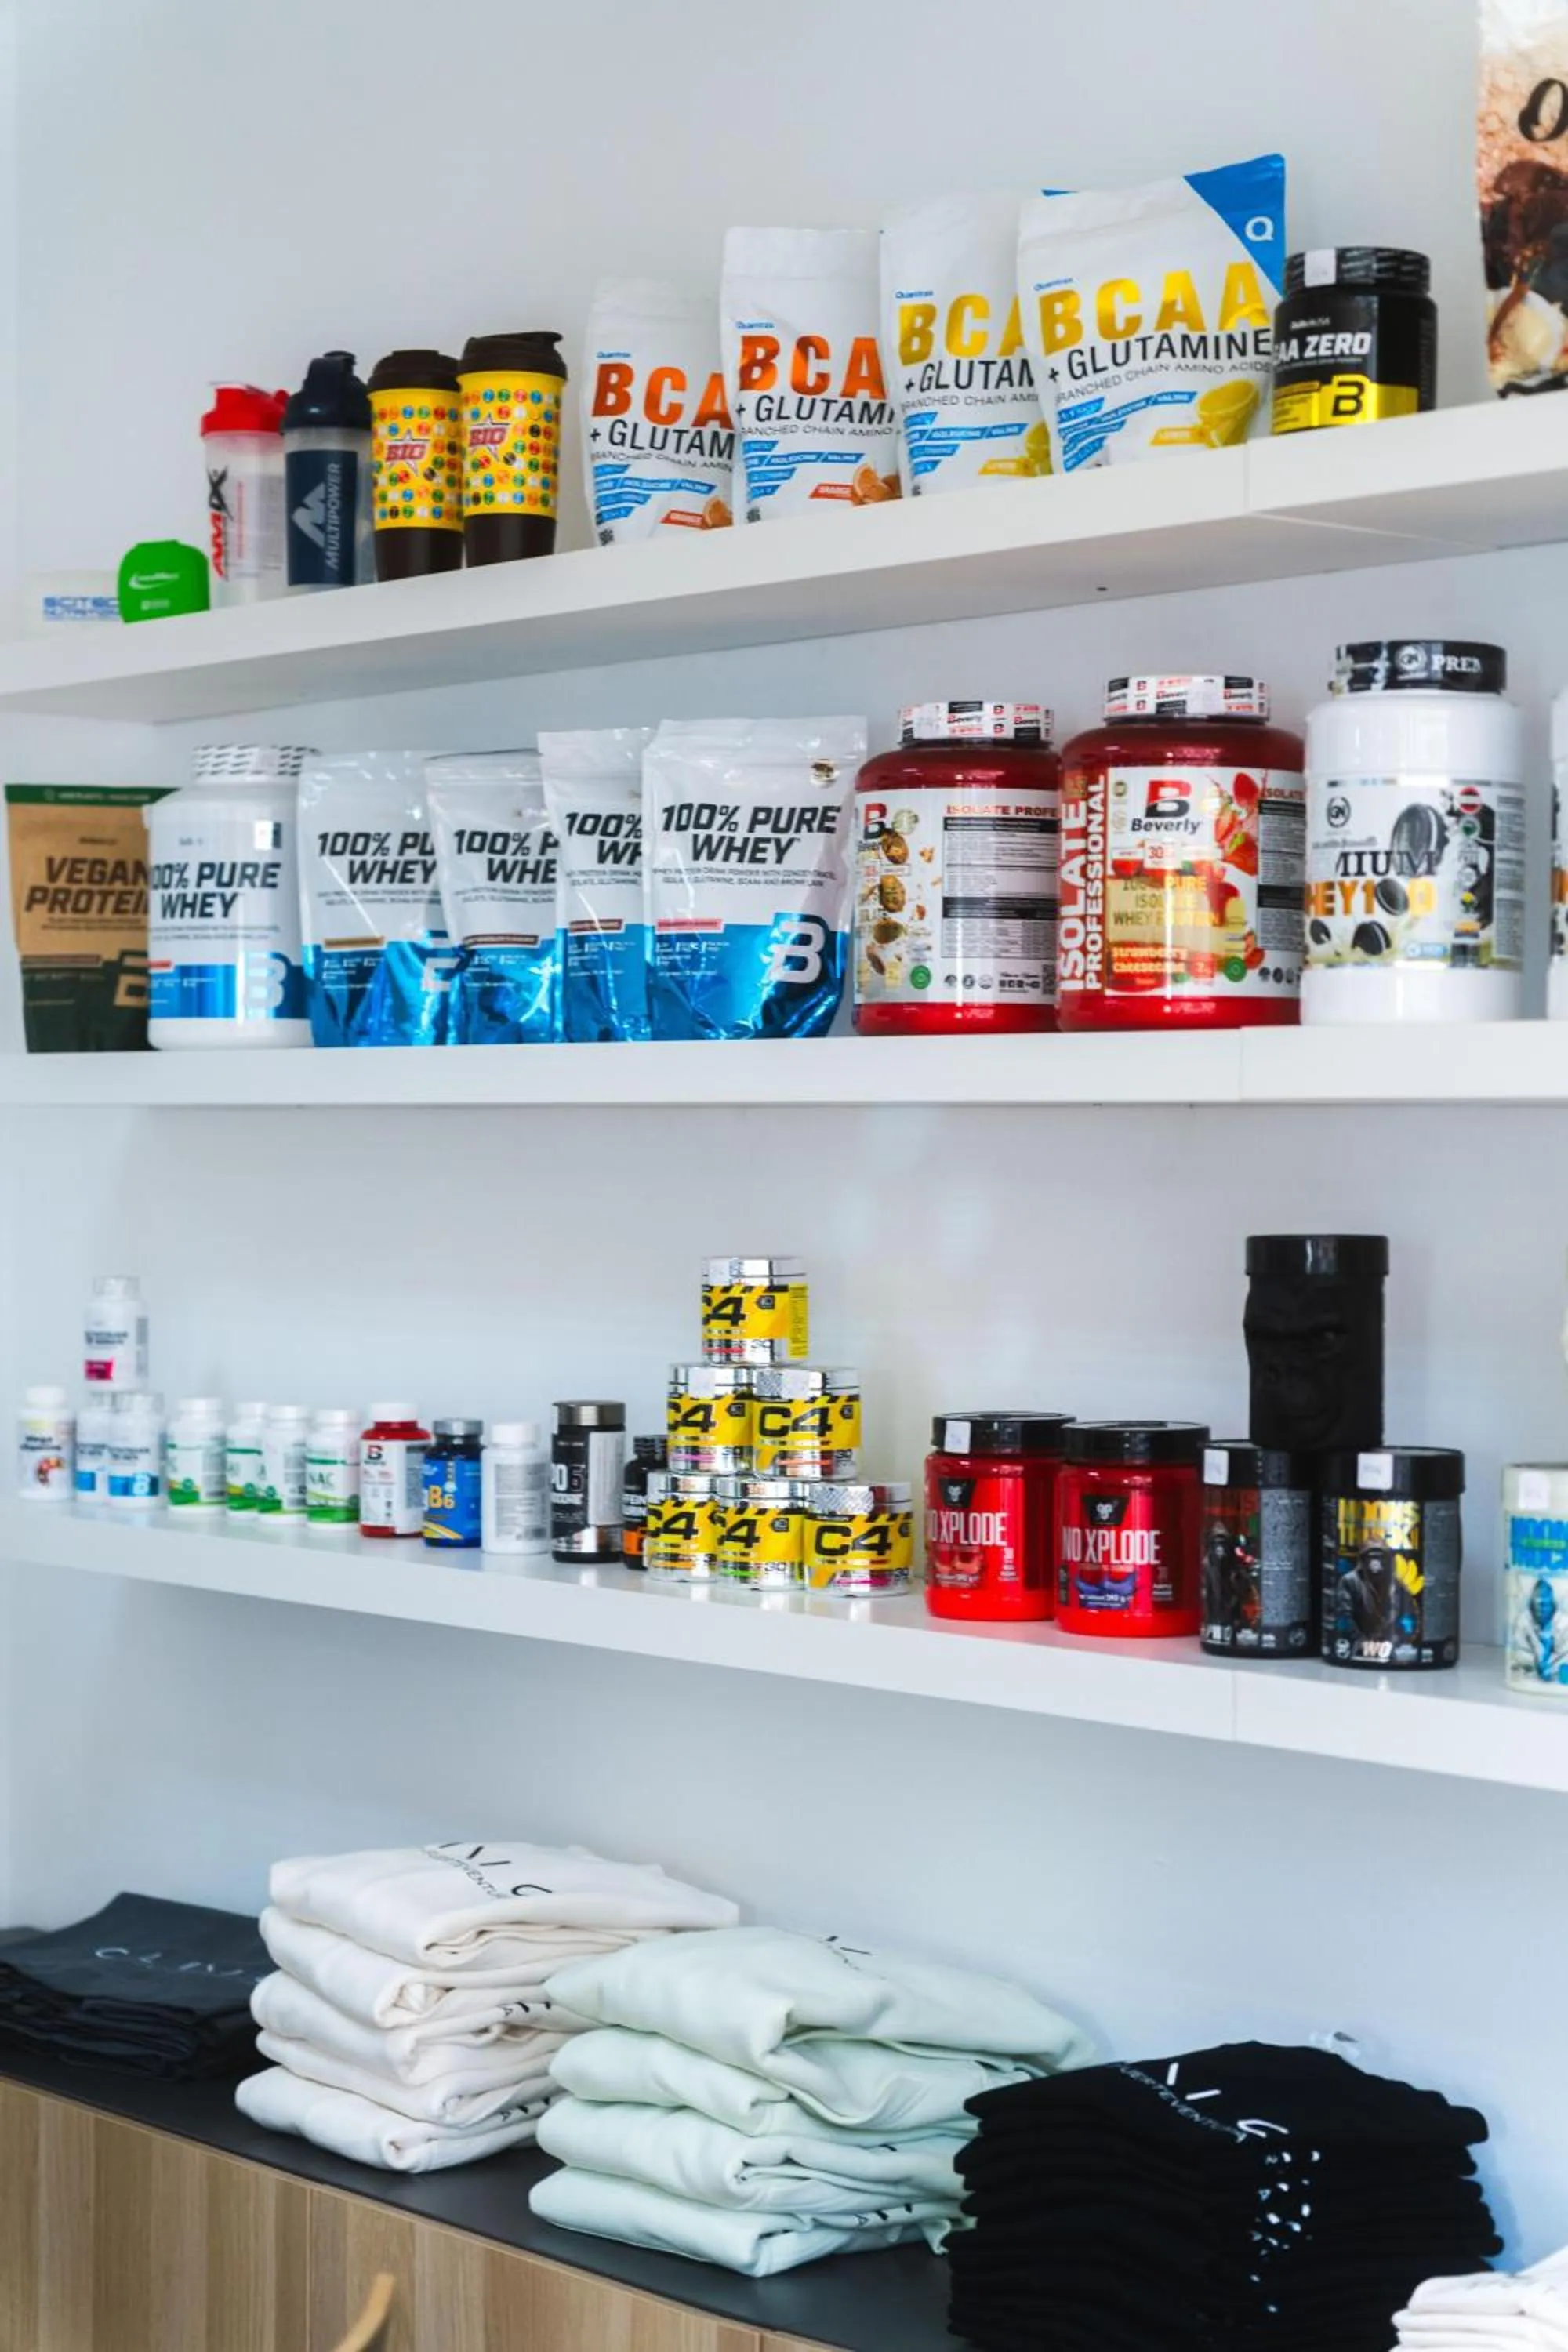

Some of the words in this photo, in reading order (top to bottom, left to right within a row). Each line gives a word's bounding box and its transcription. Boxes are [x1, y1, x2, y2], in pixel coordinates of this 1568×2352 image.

[1245, 216, 1274, 241] Q
[1039, 261, 1271, 357] BCAA
[1067, 328, 1272, 380] GLUTAMINE
[1304, 332, 1372, 358] ZERO
[1332, 377, 1366, 416] B
[325, 463, 341, 571] MULTIPOWER
[1145, 779, 1192, 818] B
[565, 811, 642, 839] 100%
[662, 803, 740, 832] 100%
[748, 805, 841, 833] PURE
[863, 802, 887, 840] B
[1131, 818, 1200, 835] Beverly
[318, 831, 391, 856] 100%
[454, 829, 530, 856] 100%
[691, 834, 795, 864] WHEY
[196, 862, 281, 889] PURE
[347, 858, 437, 884] WHEY
[1086, 774, 1105, 989] PROFESSIONAL
[161, 892, 238, 919] WHEY
[1059, 799, 1087, 991] ISOLATE
[764, 920, 826, 984] B
[759, 1406, 833, 1437] C4
[815, 1525, 892, 1556] C4
[940, 1510, 1008, 1547] XPLODE
[1085, 1529, 1161, 1565] XPLODE
